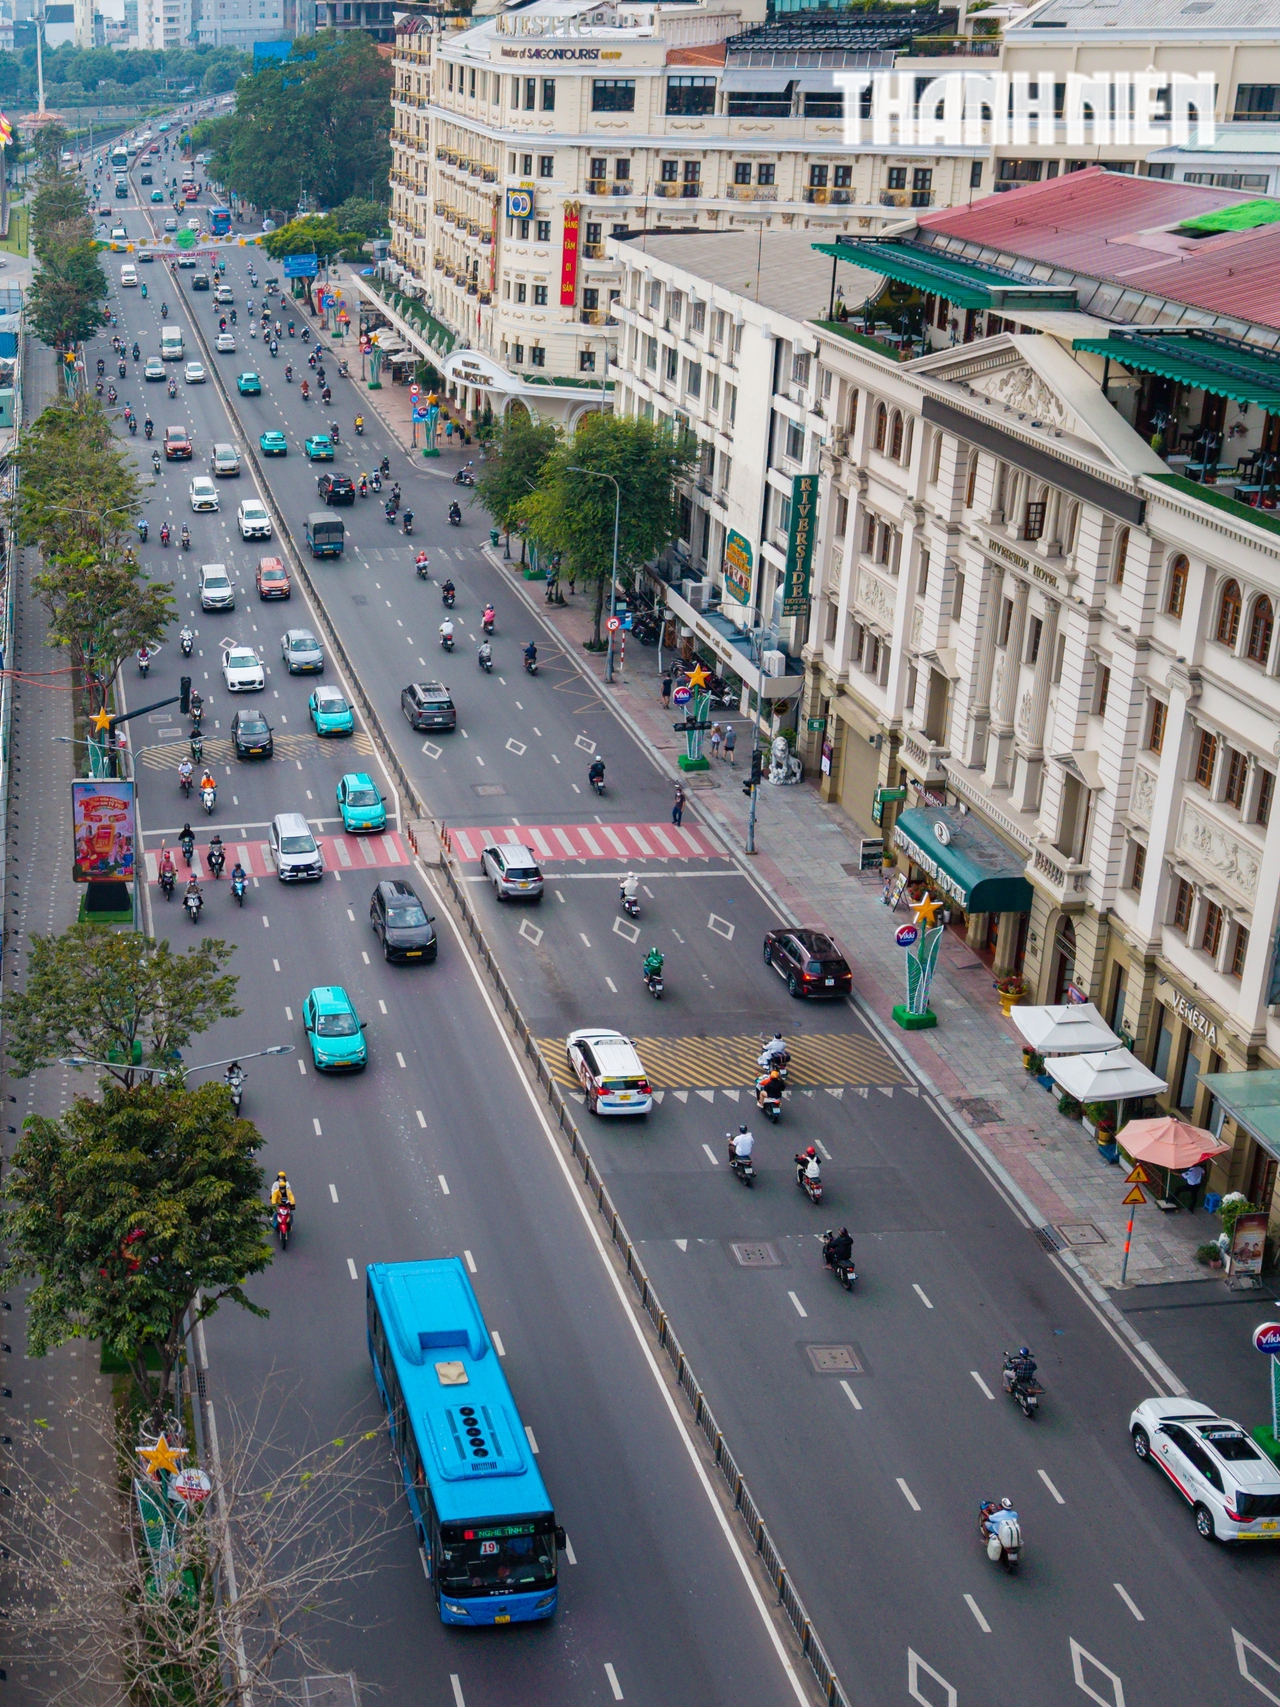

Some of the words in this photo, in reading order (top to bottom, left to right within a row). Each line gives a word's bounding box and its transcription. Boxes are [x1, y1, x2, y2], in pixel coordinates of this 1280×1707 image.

[527, 48, 600, 60] SAIGONTOURIST
[791, 477, 813, 598] RIVERSIDE
[988, 538, 1030, 573] RIVERSIDE
[1033, 565, 1060, 590] HOTEL
[893, 824, 938, 879] RIVERSIDE
[936, 866, 968, 909] HOTEL
[1172, 990, 1218, 1044] VENEZIA
[482, 1543, 495, 1554] 19
